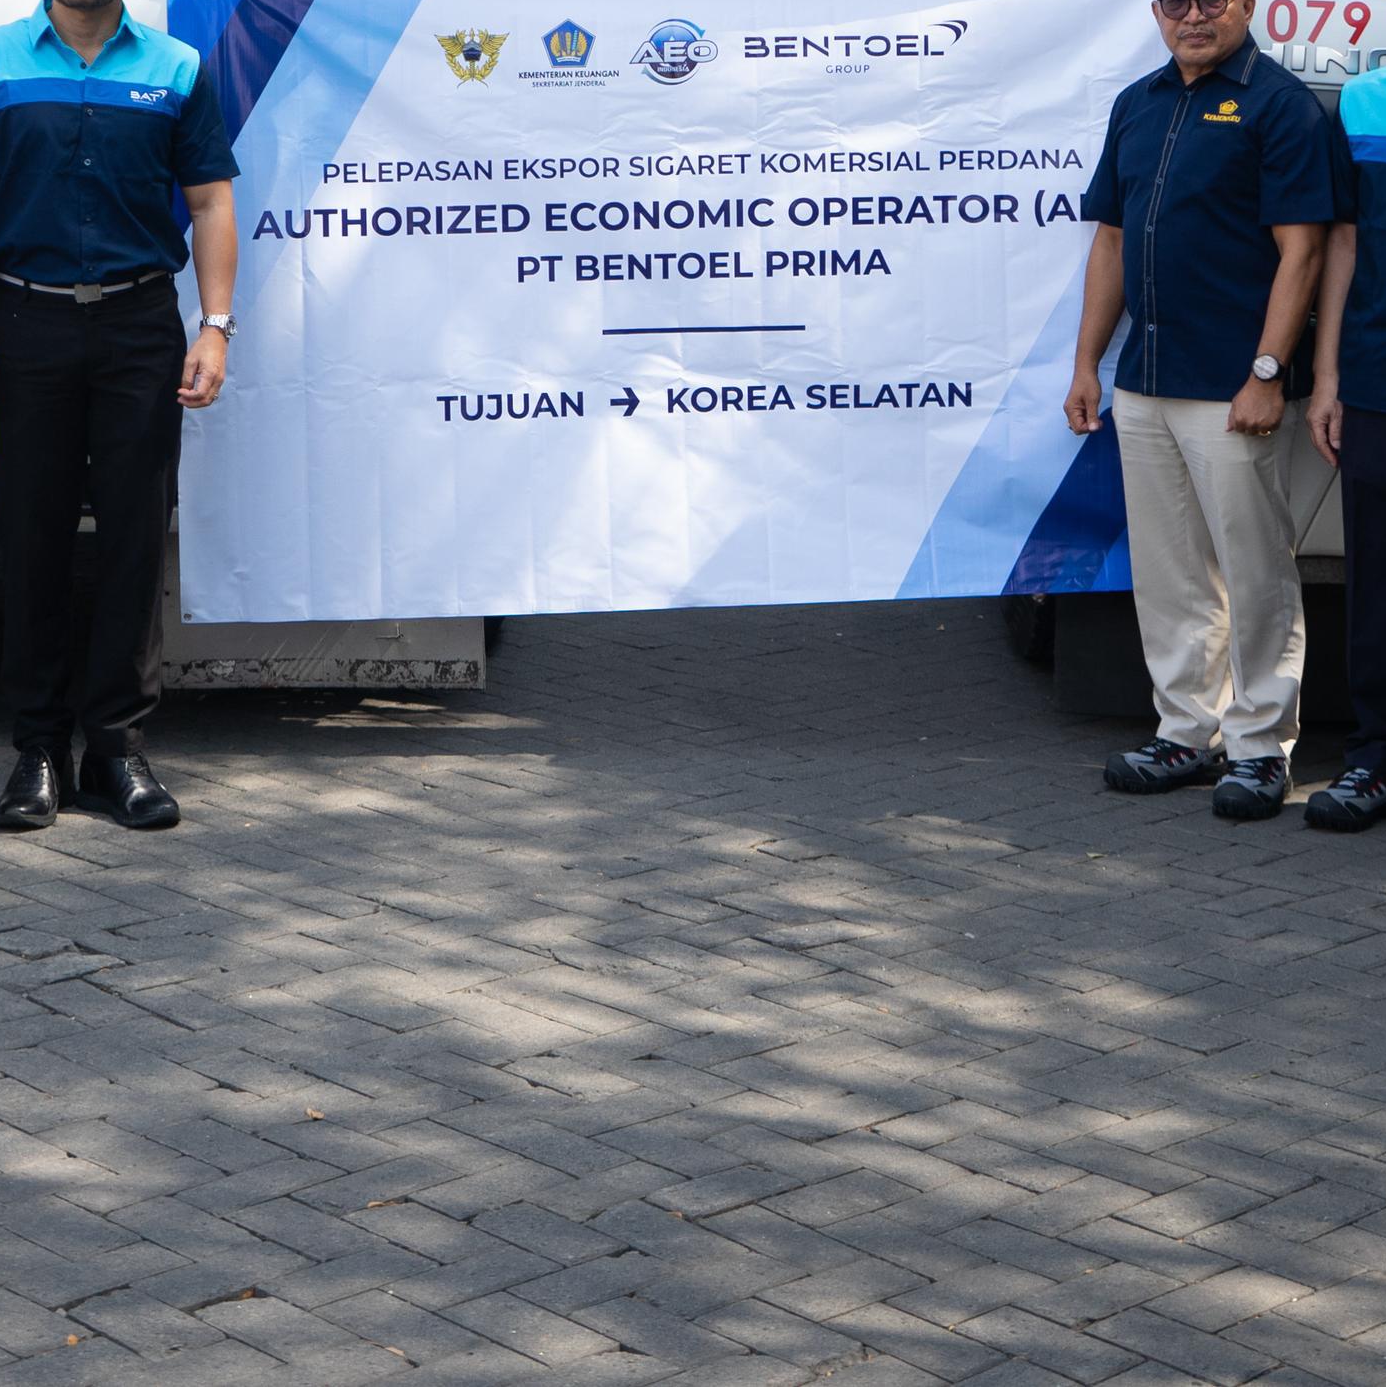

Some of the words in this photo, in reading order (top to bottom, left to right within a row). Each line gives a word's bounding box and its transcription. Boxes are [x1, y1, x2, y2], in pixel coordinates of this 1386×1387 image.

[629, 40, 718, 64] AEO
[744, 34, 945, 58] BENTOEL
[518, 70, 573, 79] KEMENTERIAN
[574, 69, 620, 78] KEUANGAN
[825, 64, 870, 74] GROUP
[532, 80, 573, 88] SEKRETARIAT
[322, 159, 493, 184] PELEPASAN
[503, 157, 620, 180] EKSPOR
[629, 154, 751, 177] SIGARET
[760, 151, 931, 174] KOMERSIAL
[939, 149, 1084, 171] PERDANA
[252, 203, 531, 241] AUTHORIZED
[545, 198, 775, 232] ECONOMIC
[788, 194, 1019, 227] OPERATOR
[517, 255, 564, 283] PT
[575, 252, 754, 282] BENTOEL
[766, 249, 892, 278] PRIMA
[436, 391, 584, 422] TUJUAN
[666, 384, 796, 414] KOREA
[806, 381, 973, 410] SELATAN
